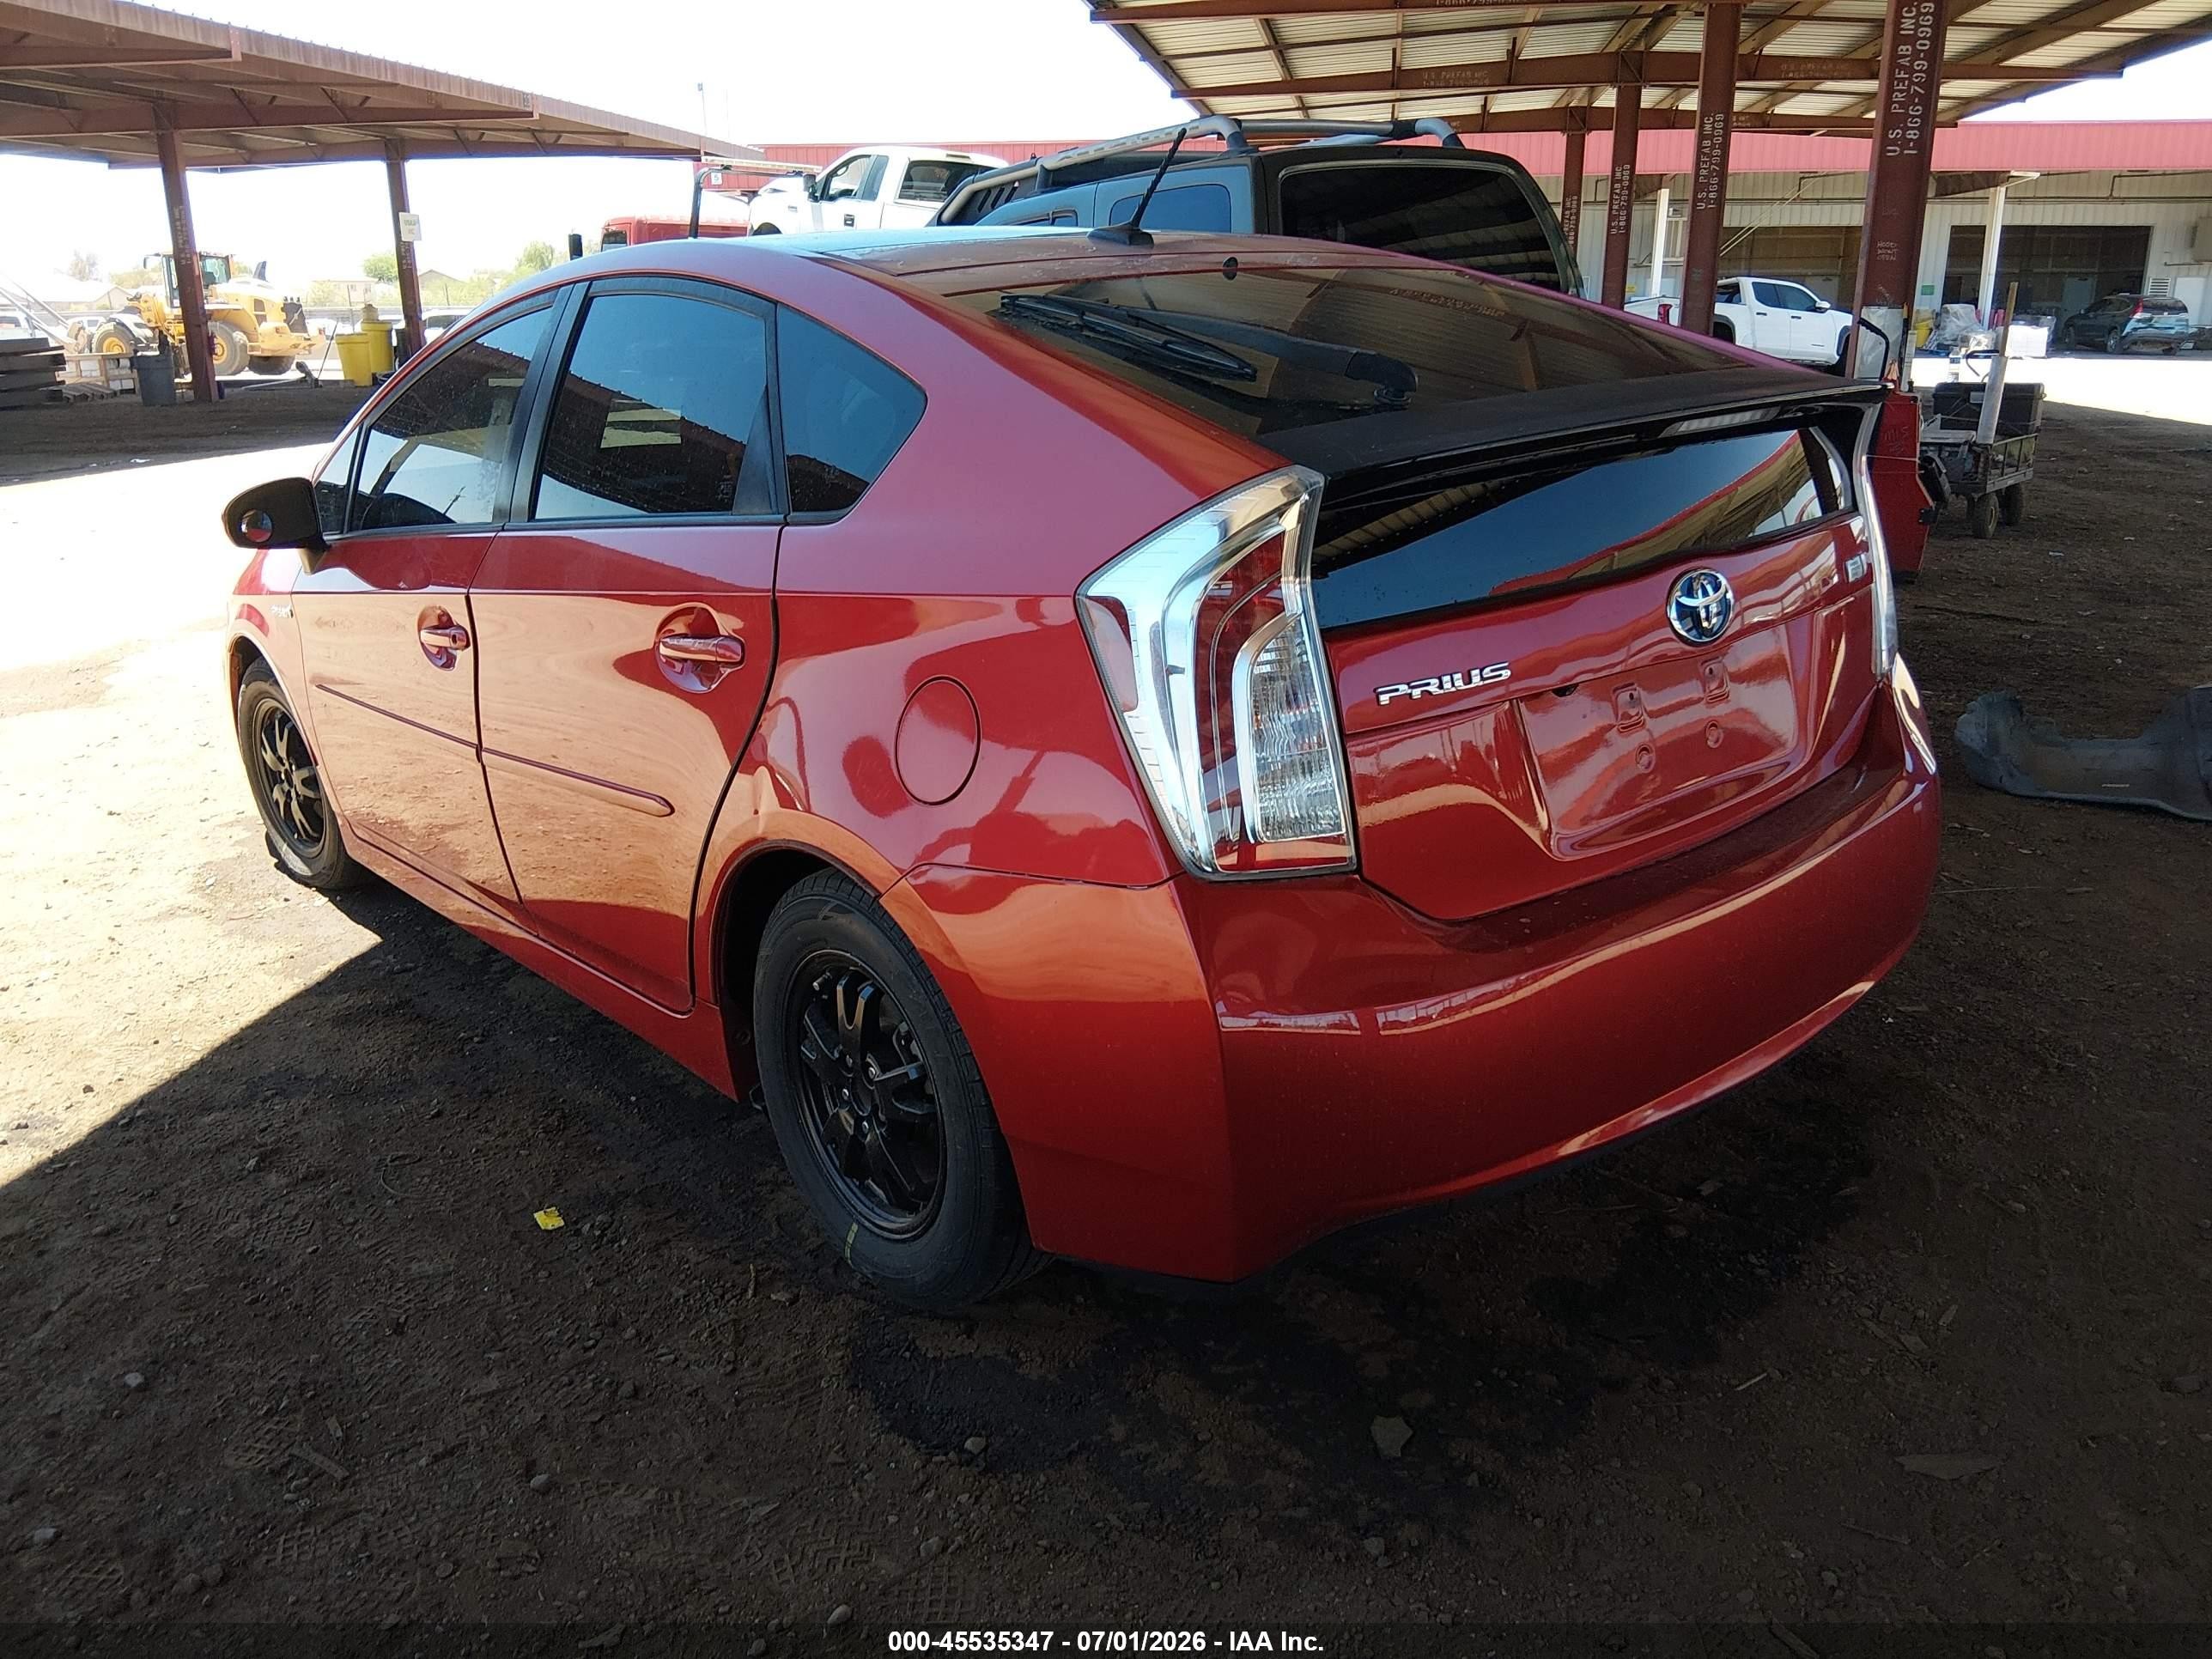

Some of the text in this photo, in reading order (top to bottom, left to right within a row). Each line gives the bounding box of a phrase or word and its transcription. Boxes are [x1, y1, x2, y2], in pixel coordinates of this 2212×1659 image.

[1886, 2, 1917, 155] U.S. PREFAB INC.
[1904, 2, 1935, 155] 1-866-799-0969
[1612, 183, 1621, 215] PREFAB
[1696, 113, 1714, 210] U.S. PREFAB INC.
[1707, 113, 1724, 209] 1-866-799-0969
[1374, 661, 1511, 705] PRIUS
